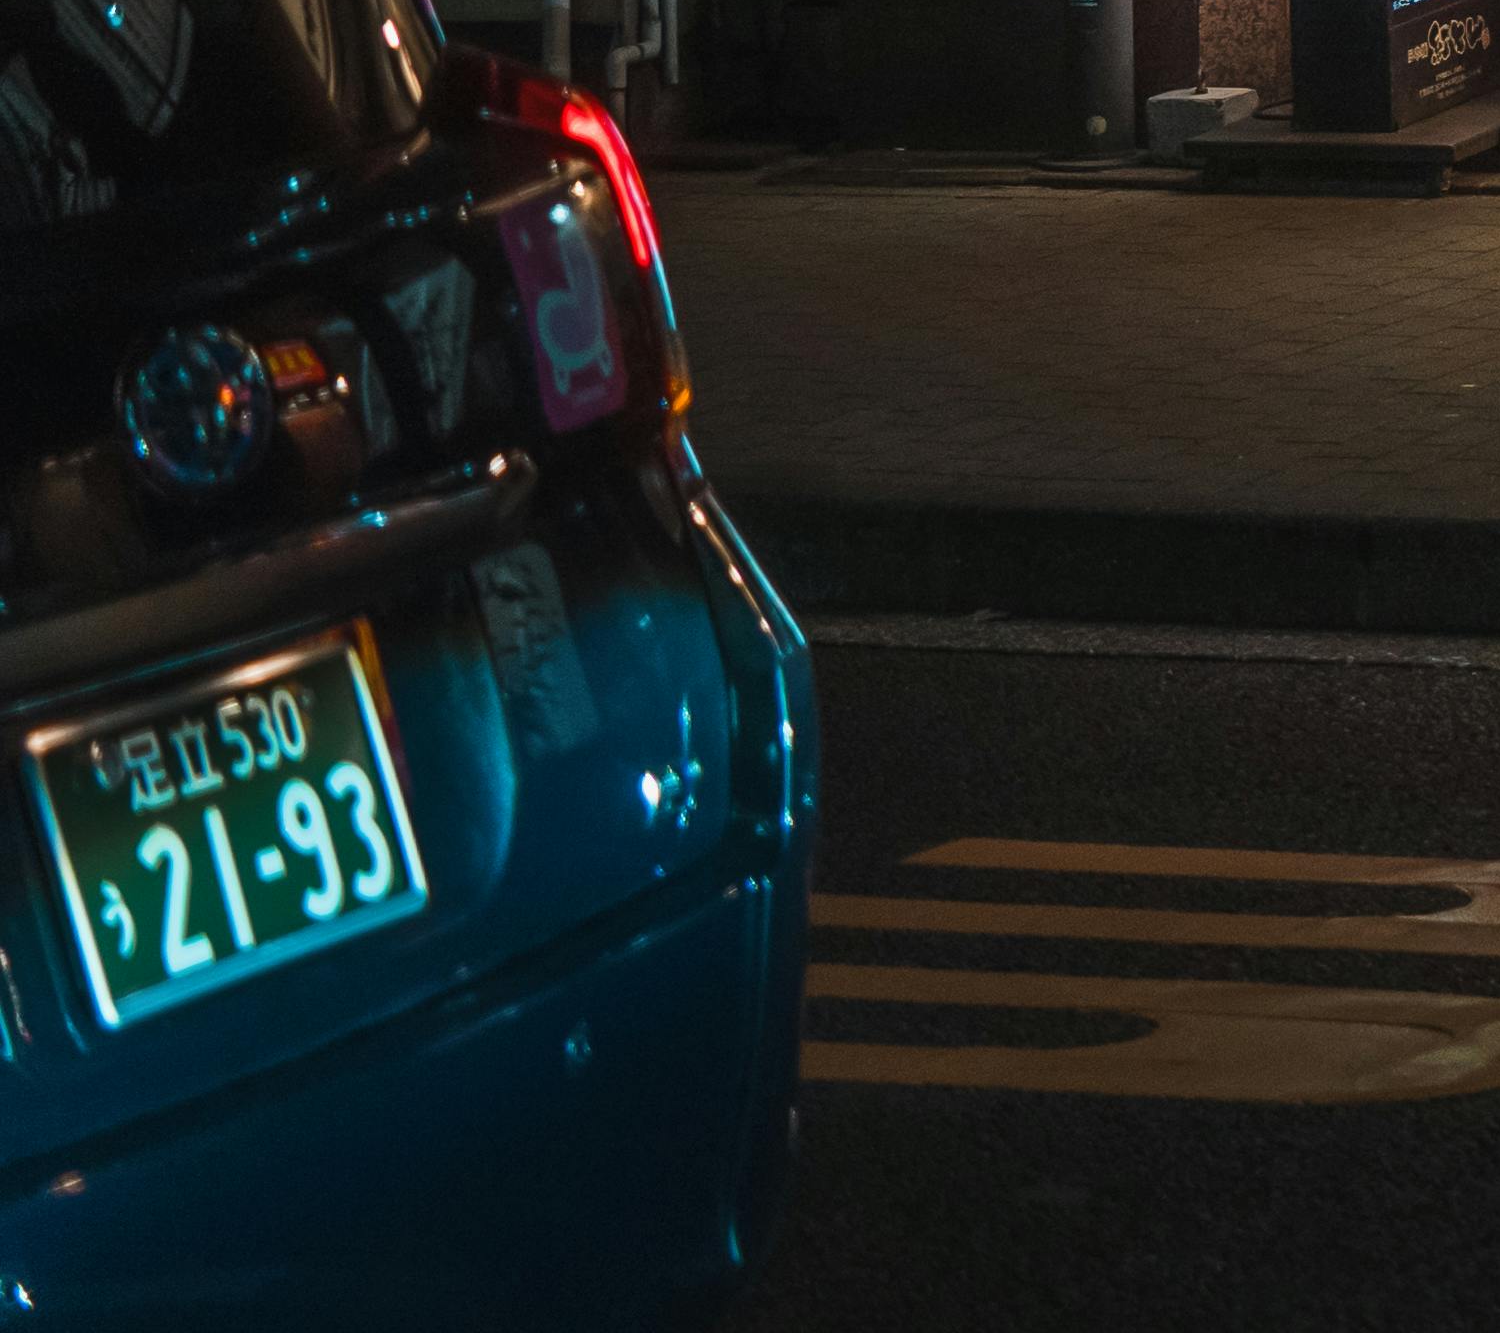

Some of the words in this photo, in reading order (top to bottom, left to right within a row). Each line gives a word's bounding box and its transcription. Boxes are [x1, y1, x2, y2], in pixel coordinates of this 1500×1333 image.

[122, 719, 224, 813] 足立
[216, 687, 308, 780] 530
[137, 760, 394, 977] 21-93
